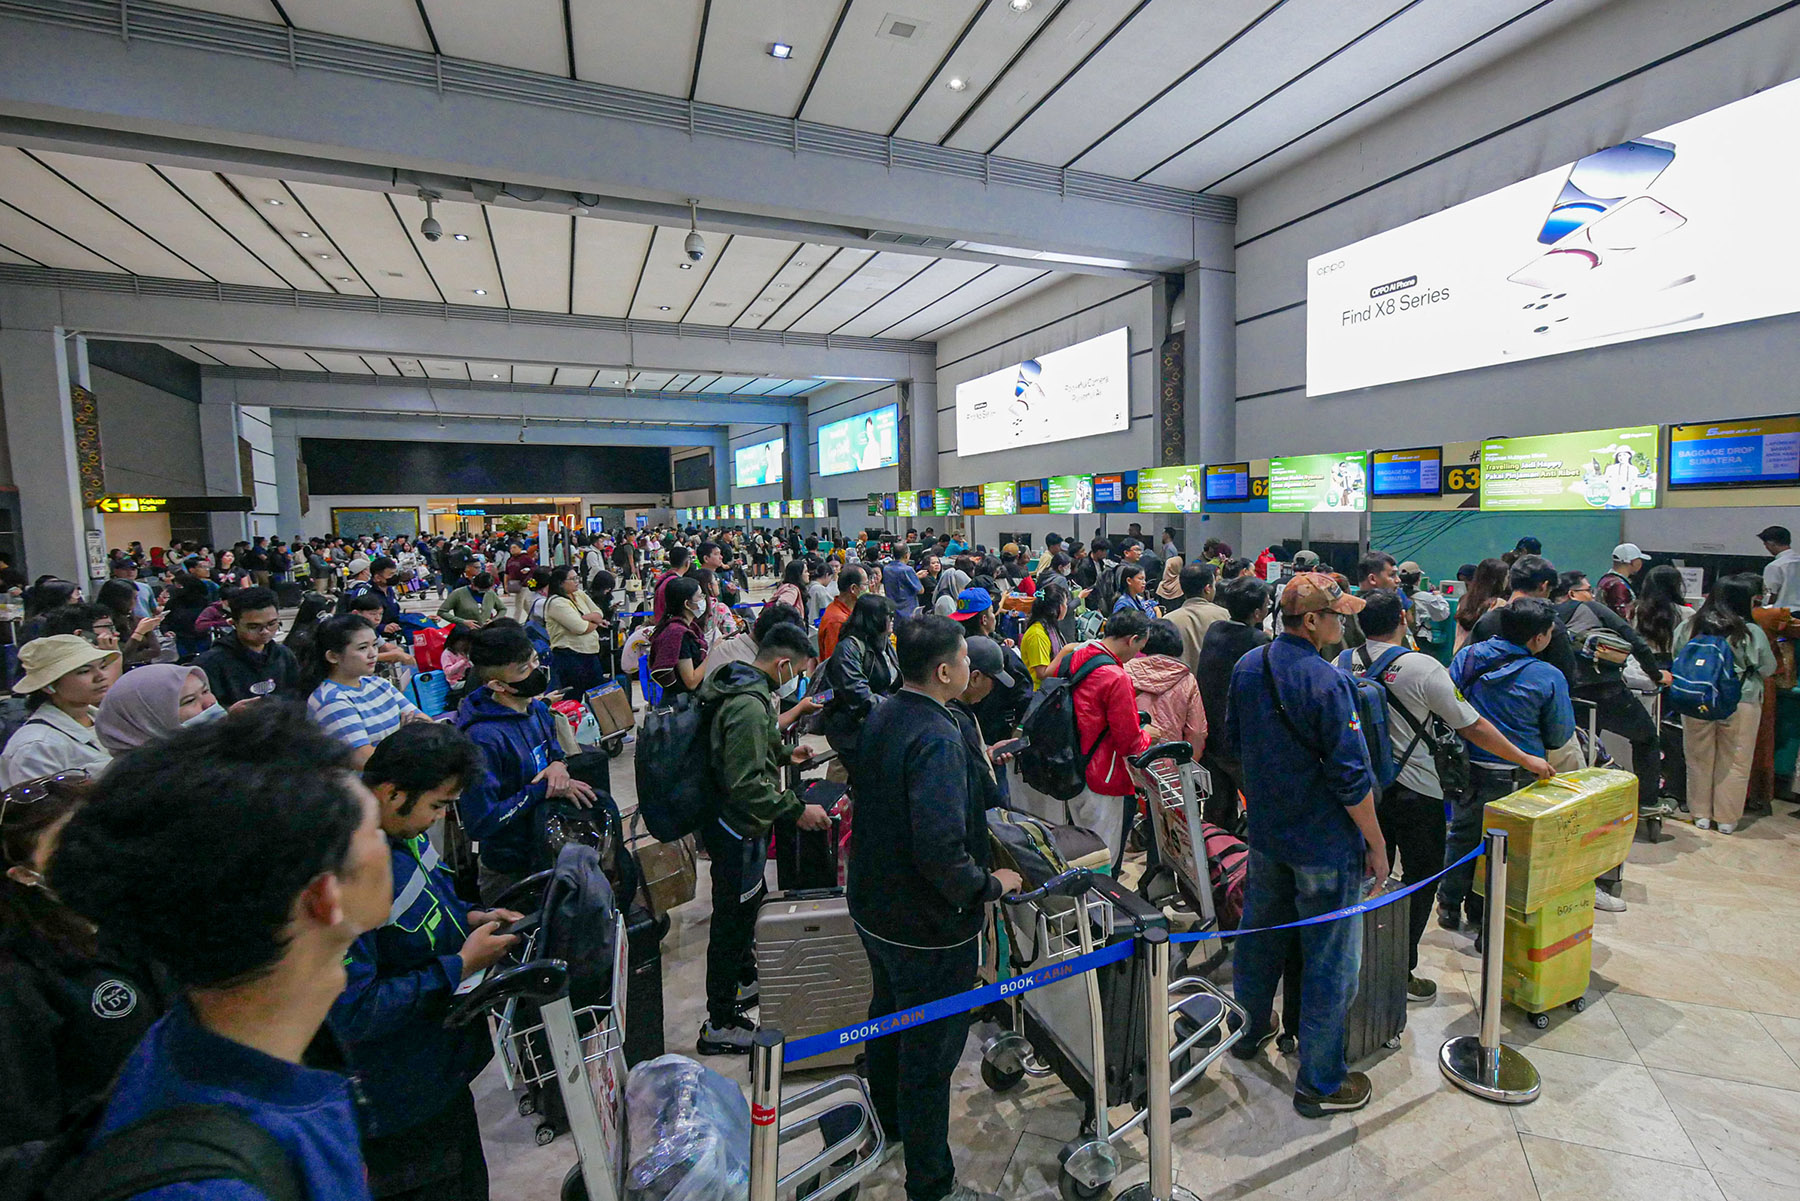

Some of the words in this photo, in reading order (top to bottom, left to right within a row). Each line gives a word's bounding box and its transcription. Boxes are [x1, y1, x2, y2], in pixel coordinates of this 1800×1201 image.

[1371, 285, 1389, 296] OPPO
[1396, 278, 1416, 290] Phone
[1341, 305, 1371, 327] Find
[1375, 298, 1396, 318] X8
[1400, 287, 1450, 311] Series
[1678, 448, 1725, 458] BAGGAGE
[1727, 446, 1755, 456] DROP
[1485, 463, 1520, 472] Travelling
[1537, 461, 1563, 469] Happy
[1689, 456, 1742, 466] SUMATERA
[1448, 468, 1480, 490] 63
[1485, 472, 1505, 480] Pakai
[1505, 471, 1540, 480] Pinjaman
[1540, 470, 1557, 478] Anti
[1558, 468, 1580, 477] Ribet
